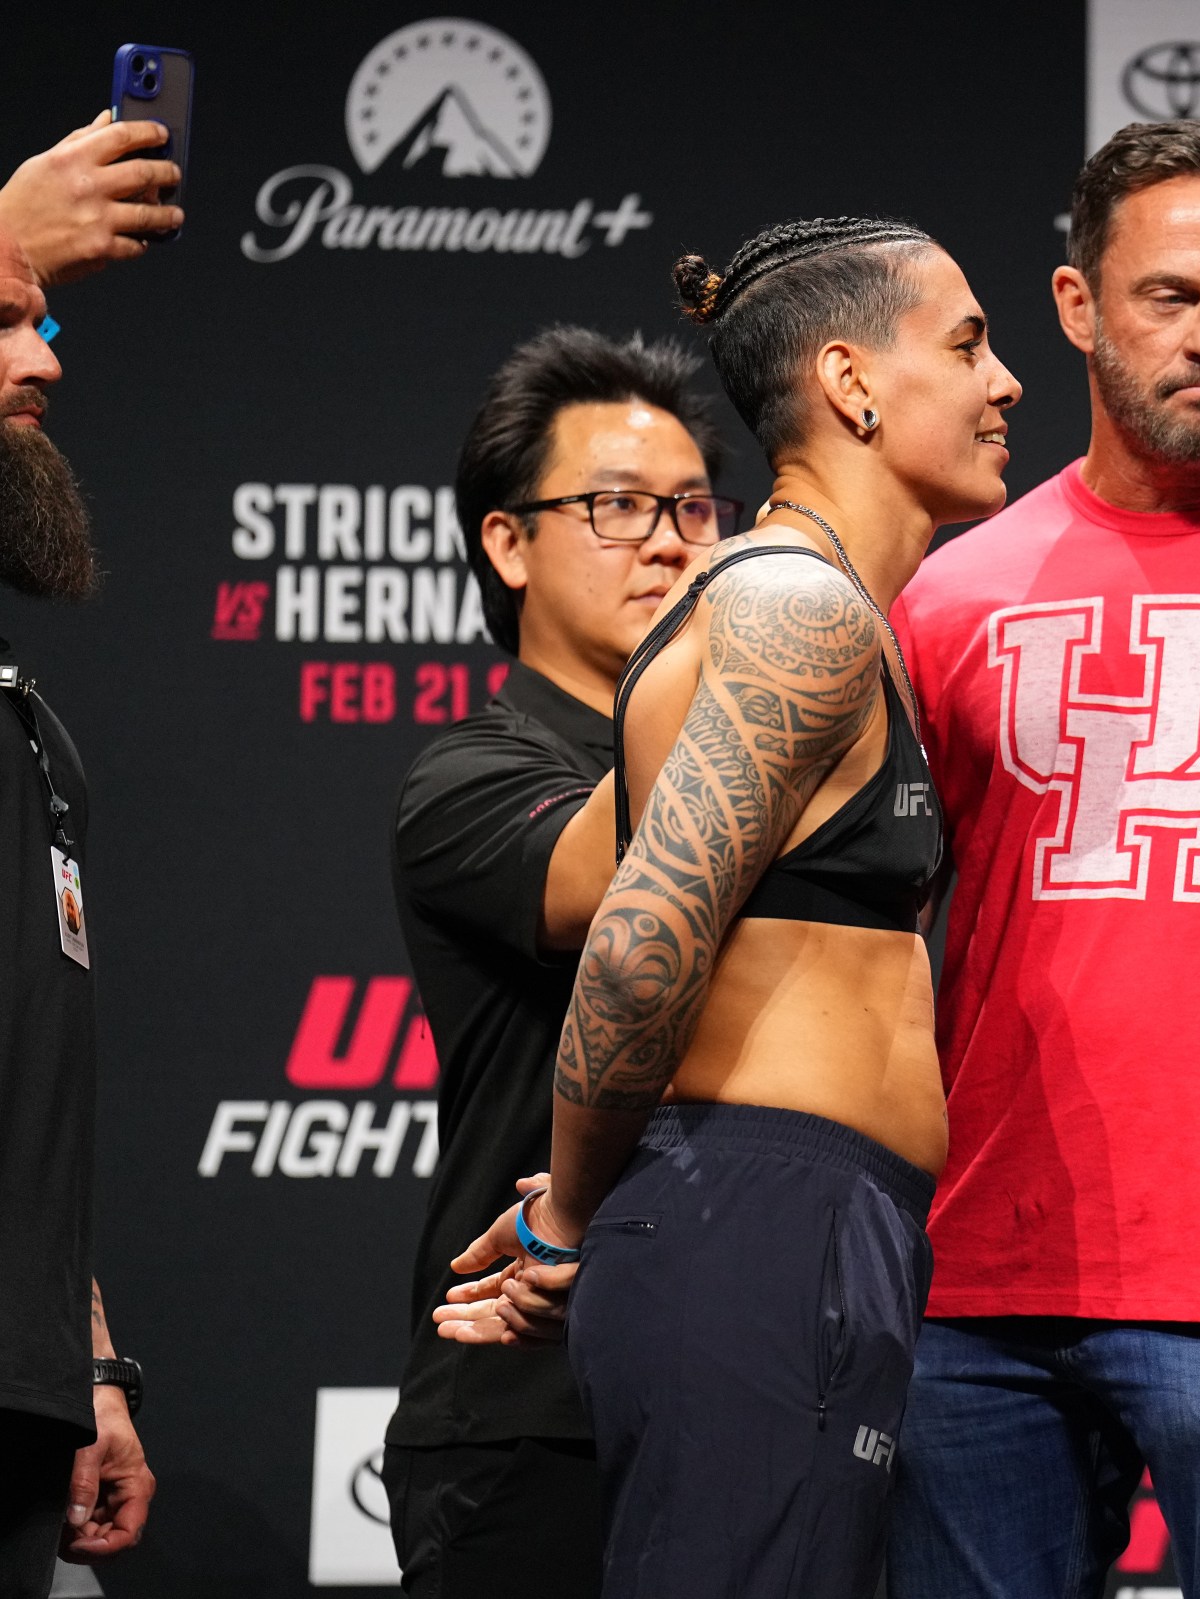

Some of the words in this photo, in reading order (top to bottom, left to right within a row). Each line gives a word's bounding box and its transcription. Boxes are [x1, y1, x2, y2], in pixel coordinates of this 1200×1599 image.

[241, 164, 652, 262] Paramount+
[215, 580, 269, 625] VS
[300, 661, 396, 722] FEB
[414, 662, 468, 723] 21
[62, 868, 73, 883] UFC
[198, 1100, 440, 1178] FIGHT
